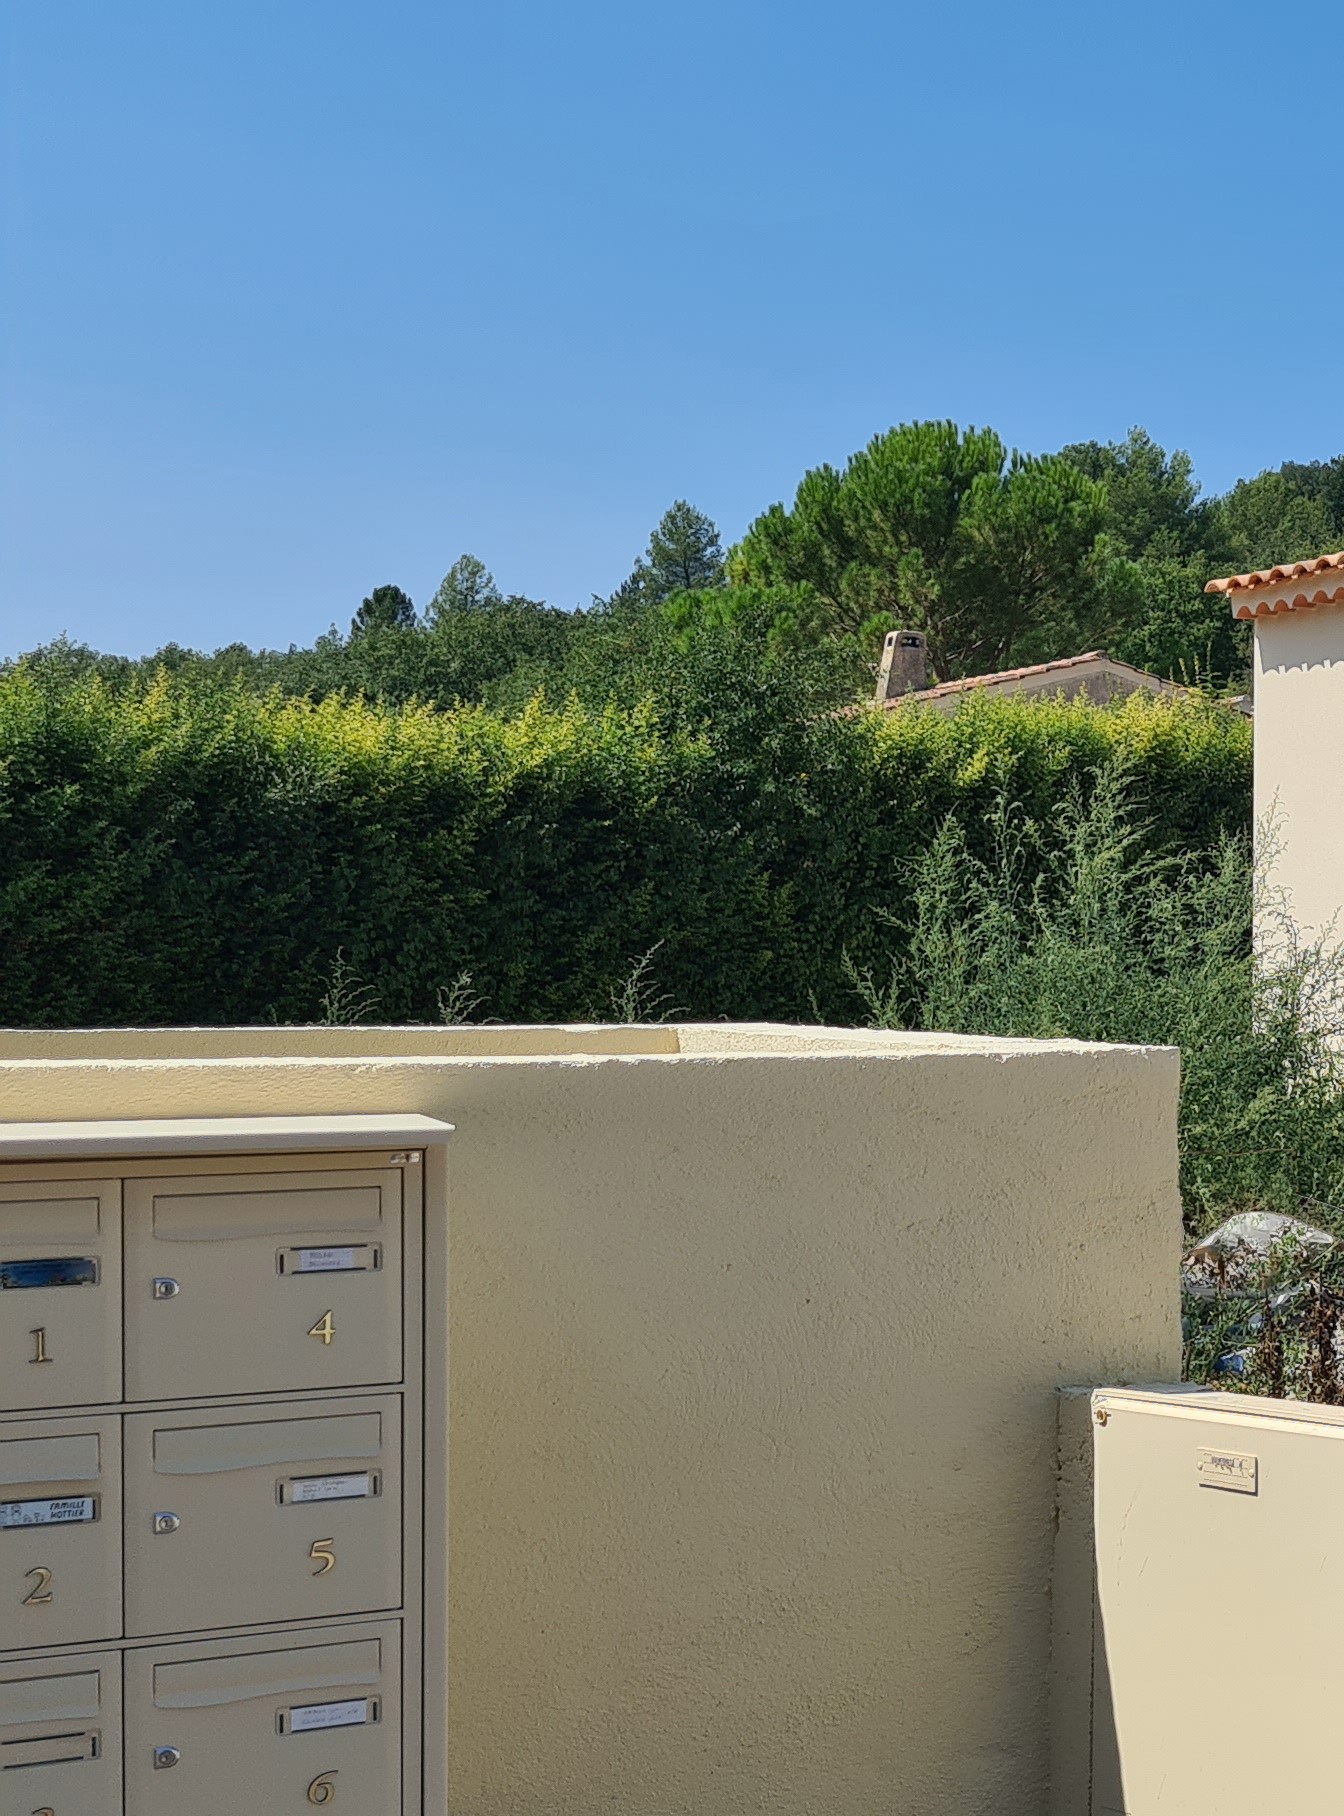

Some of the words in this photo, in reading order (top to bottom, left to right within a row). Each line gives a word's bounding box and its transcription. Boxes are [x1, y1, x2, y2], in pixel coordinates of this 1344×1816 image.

[28, 1327, 53, 1364] 1
[307, 1309, 336, 1345] 4
[309, 1537, 336, 1576] 5
[21, 1567, 53, 1605] 2
[307, 1770, 339, 1806] 6
